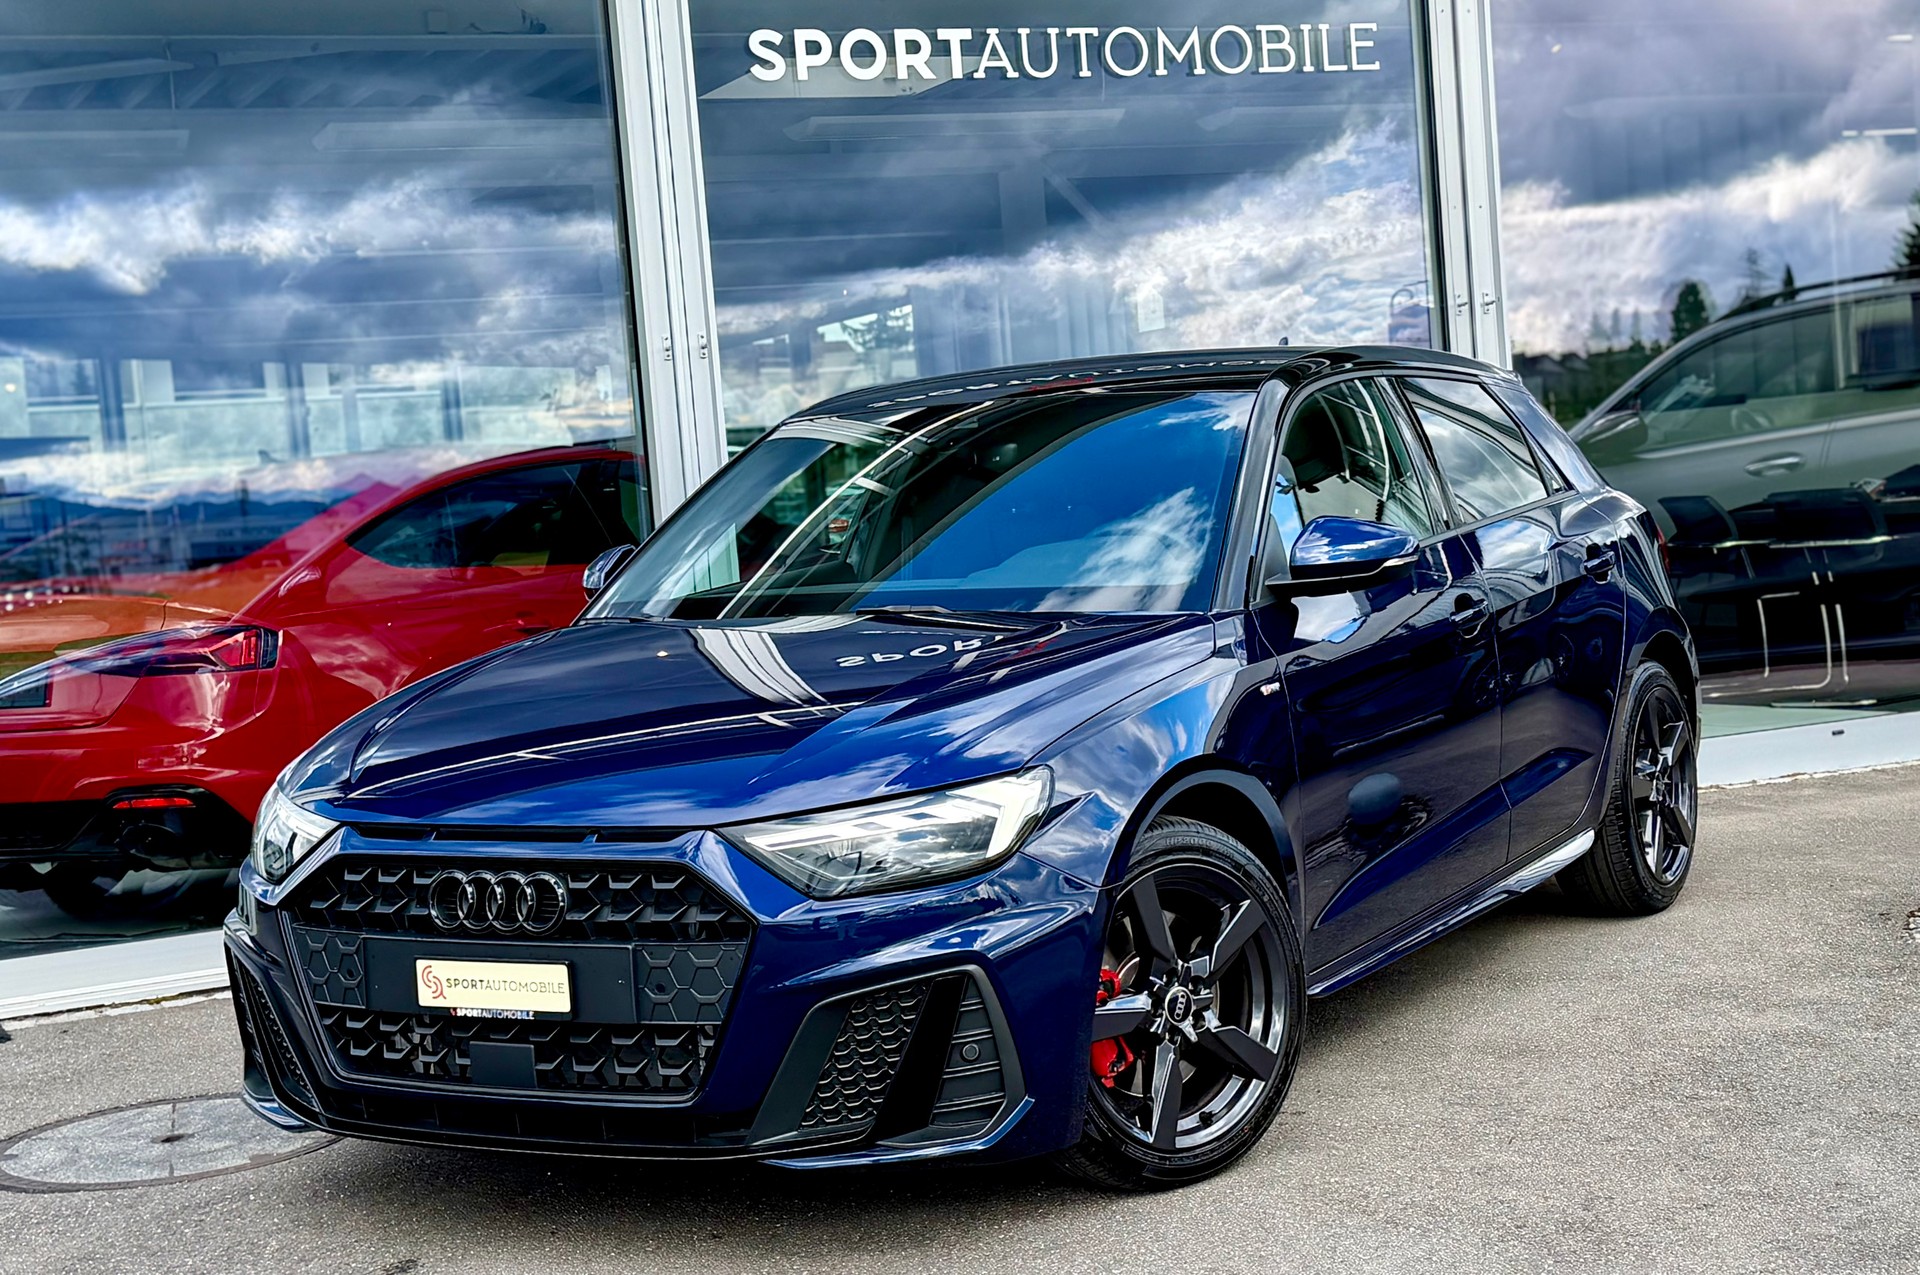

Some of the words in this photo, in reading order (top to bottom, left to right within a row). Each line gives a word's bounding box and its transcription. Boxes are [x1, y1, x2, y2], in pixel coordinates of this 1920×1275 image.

[748, 22, 1381, 82] SPORTAUTOMOBILE
[446, 978, 566, 995] SPORTAUTOMOBILE
[456, 1007, 535, 1020] SPORTAUTOMOBILE
